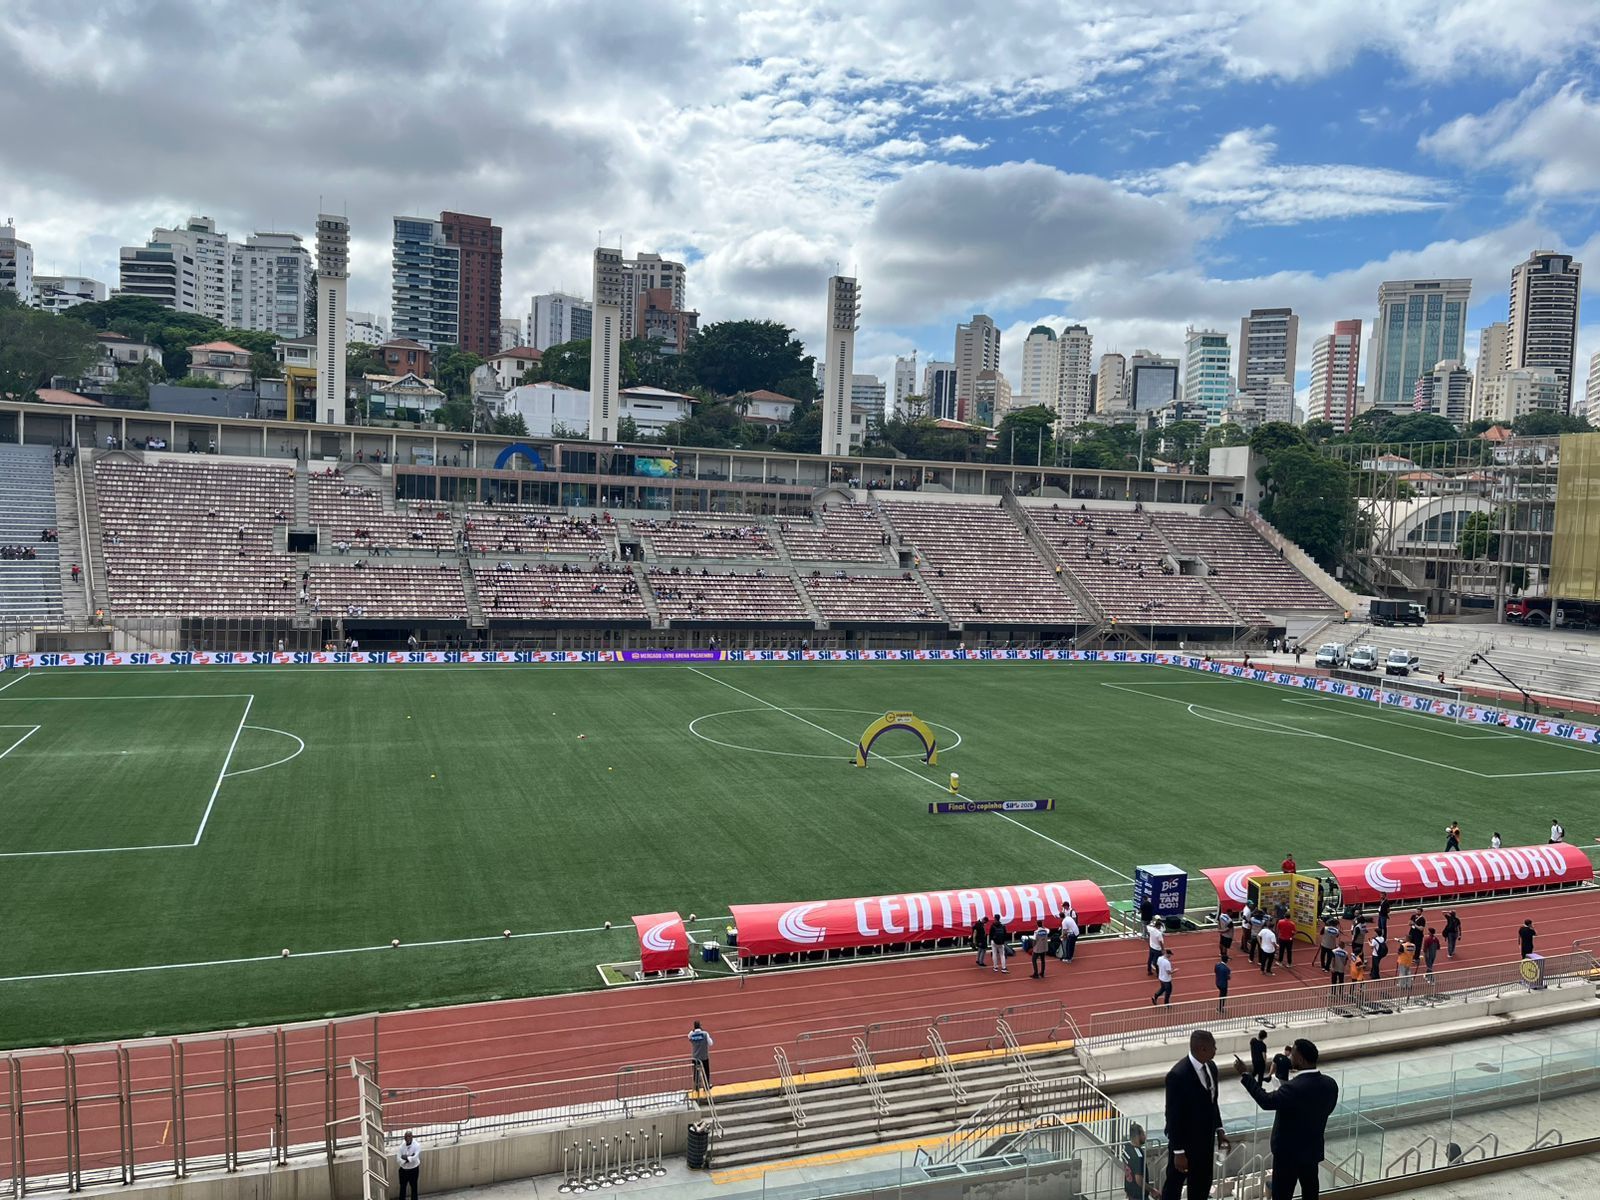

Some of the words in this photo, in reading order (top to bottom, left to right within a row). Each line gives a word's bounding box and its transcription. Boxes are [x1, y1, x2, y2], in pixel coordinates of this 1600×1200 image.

[40, 654, 59, 665] Sil
[84, 652, 105, 665] Sil
[130, 653, 149, 664] Sil
[170, 652, 192, 665] Sil
[215, 652, 234, 664] Sil
[252, 652, 273, 664] Sil
[294, 653, 312, 663] Sil
[334, 653, 350, 662] Sil
[368, 652, 388, 663] Sil
[409, 653, 424, 663] Sil
[444, 652, 461, 663] Sil
[482, 652, 496, 662] Sil
[514, 652, 532, 662] Sil
[551, 652, 565, 662] Sil
[582, 651, 598, 662] Sil
[730, 650, 744, 660] Sil
[761, 650, 773, 660] Sil
[788, 650, 802, 660] Sil
[819, 651, 831, 660] Sil
[846, 650, 859, 660] Sil
[875, 650, 888, 660] Sil
[900, 650, 914, 660] Sil
[929, 650, 940, 660] Sil
[953, 650, 967, 660] Sil
[980, 650, 992, 660] Sil
[1006, 650, 1017, 660] Sil
[1030, 650, 1045, 660] Sil
[1058, 650, 1070, 660] Sil
[1083, 650, 1098, 660] Sil
[1113, 652, 1127, 662] Sil
[1140, 654, 1156, 664] Sil
[1190, 658, 1200, 670] Sil
[1210, 663, 1220, 672] Sil
[1232, 667, 1243, 676] Sil
[1252, 671, 1266, 680] Sil
[1278, 674, 1290, 685] Sil
[1302, 676, 1316, 690] Sil
[1332, 681, 1344, 693] Sil
[1358, 688, 1373, 701] Sil
[1387, 693, 1401, 705] Sil
[1414, 698, 1431, 711] Sil
[1482, 711, 1499, 723] Sil
[1514, 716, 1536, 732] Sil
[1555, 724, 1574, 738] Sil
[1410, 846, 1567, 888] CENTAURO
[854, 883, 1072, 936] CENTAURO
